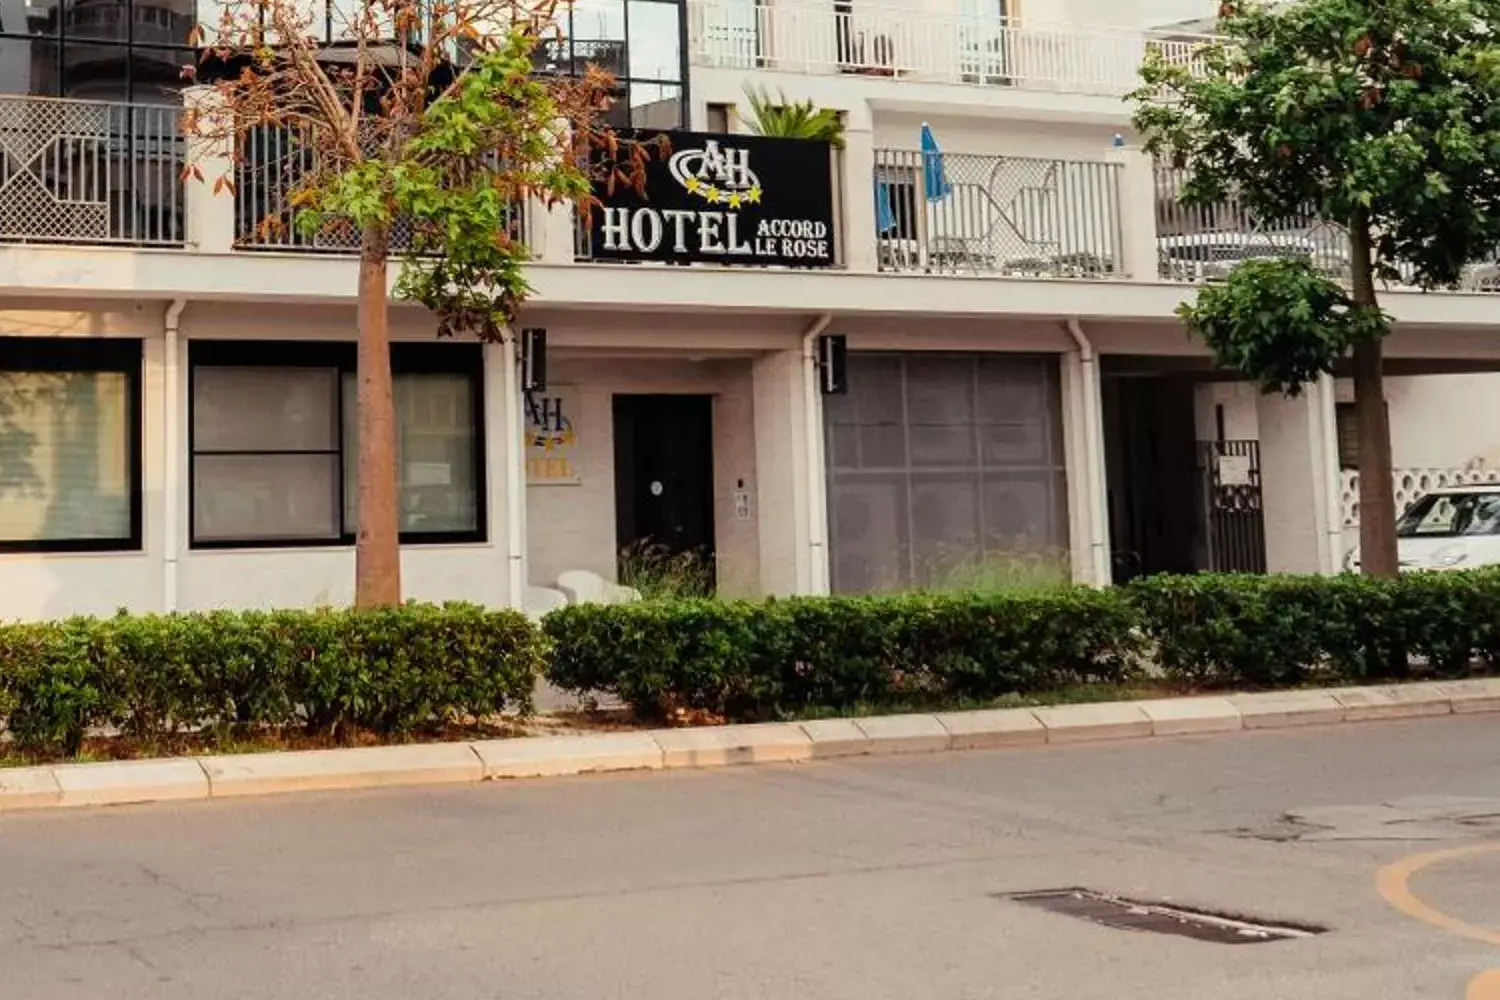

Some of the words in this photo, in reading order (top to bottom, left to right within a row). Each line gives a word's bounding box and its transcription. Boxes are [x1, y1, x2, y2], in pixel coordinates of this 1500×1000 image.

[601, 206, 753, 255] HOTEL
[756, 218, 828, 239] ACCORD
[755, 238, 777, 255] LE
[781, 239, 829, 258] ROSE
